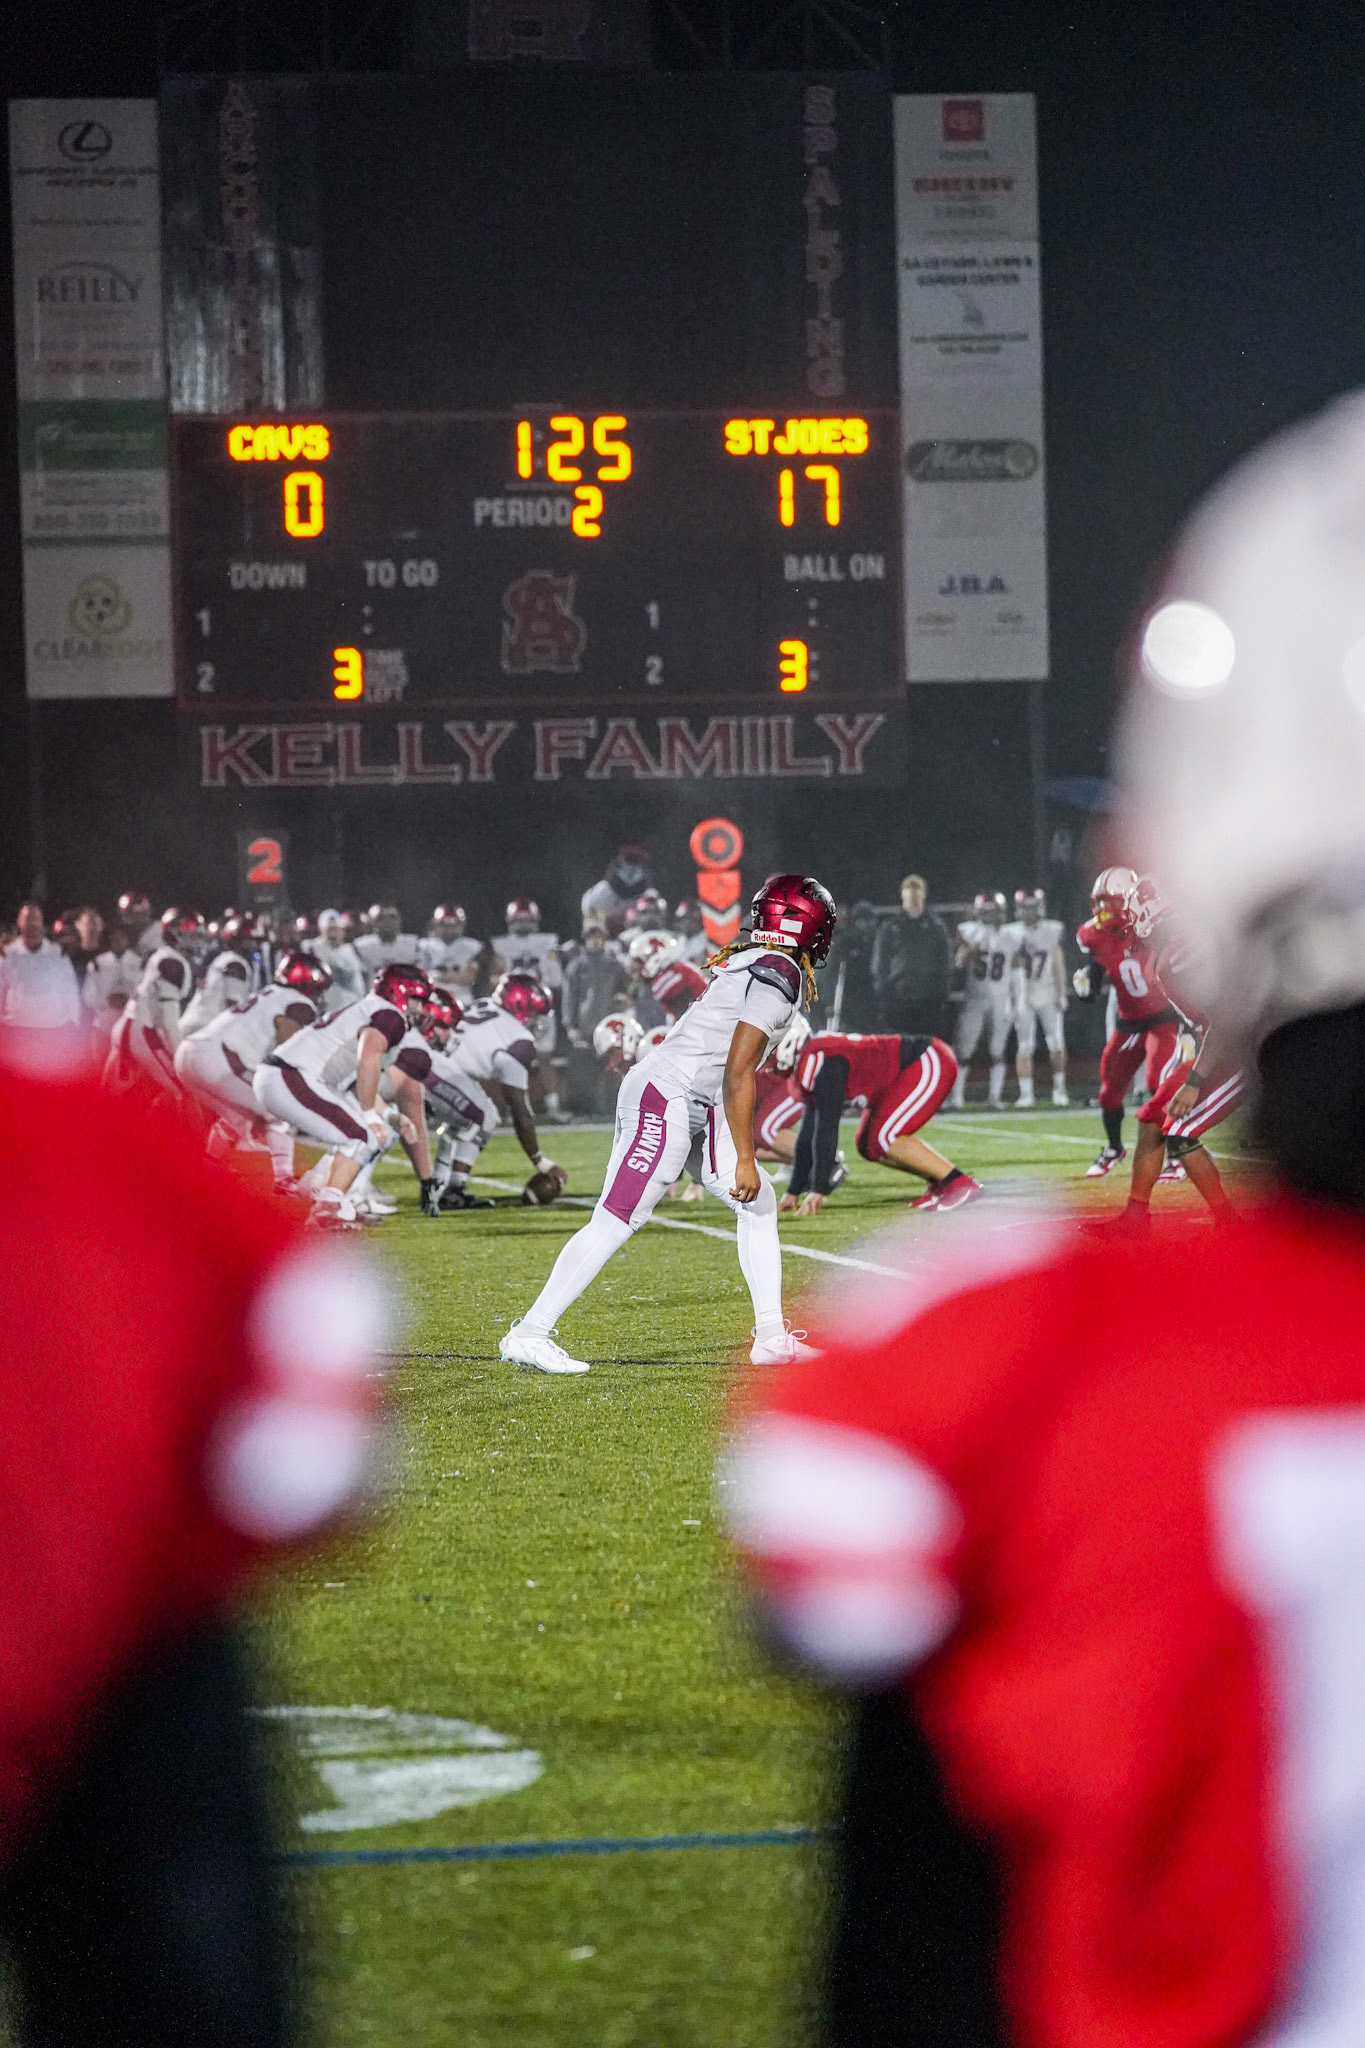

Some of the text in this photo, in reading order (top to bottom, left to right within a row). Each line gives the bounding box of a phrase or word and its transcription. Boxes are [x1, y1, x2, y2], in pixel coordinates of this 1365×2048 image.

[38, 276, 143, 302] REILLY
[228, 424, 331, 461] CAVS
[283, 470, 325, 538] 0
[473, 497, 571, 527] PERIOD
[571, 484, 604, 538] 2
[778, 464, 841, 527] 17
[230, 562, 307, 589] DOWN
[363, 559, 440, 588] TO GO
[783, 552, 885, 581] BALL ON
[197, 607, 211, 637] 1
[645, 601, 660, 629] 1
[197, 661, 215, 693] 2
[333, 647, 365, 700] 3
[646, 655, 663, 685] 2
[778, 639, 809, 692] 3
[199, 713, 886, 788] KELLY FAMILY
[247, 837, 283, 883] 2
[754, 933, 785, 945] Riddell
[1118, 958, 1149, 998] 0
[626, 1112, 664, 1174] HAWKS
